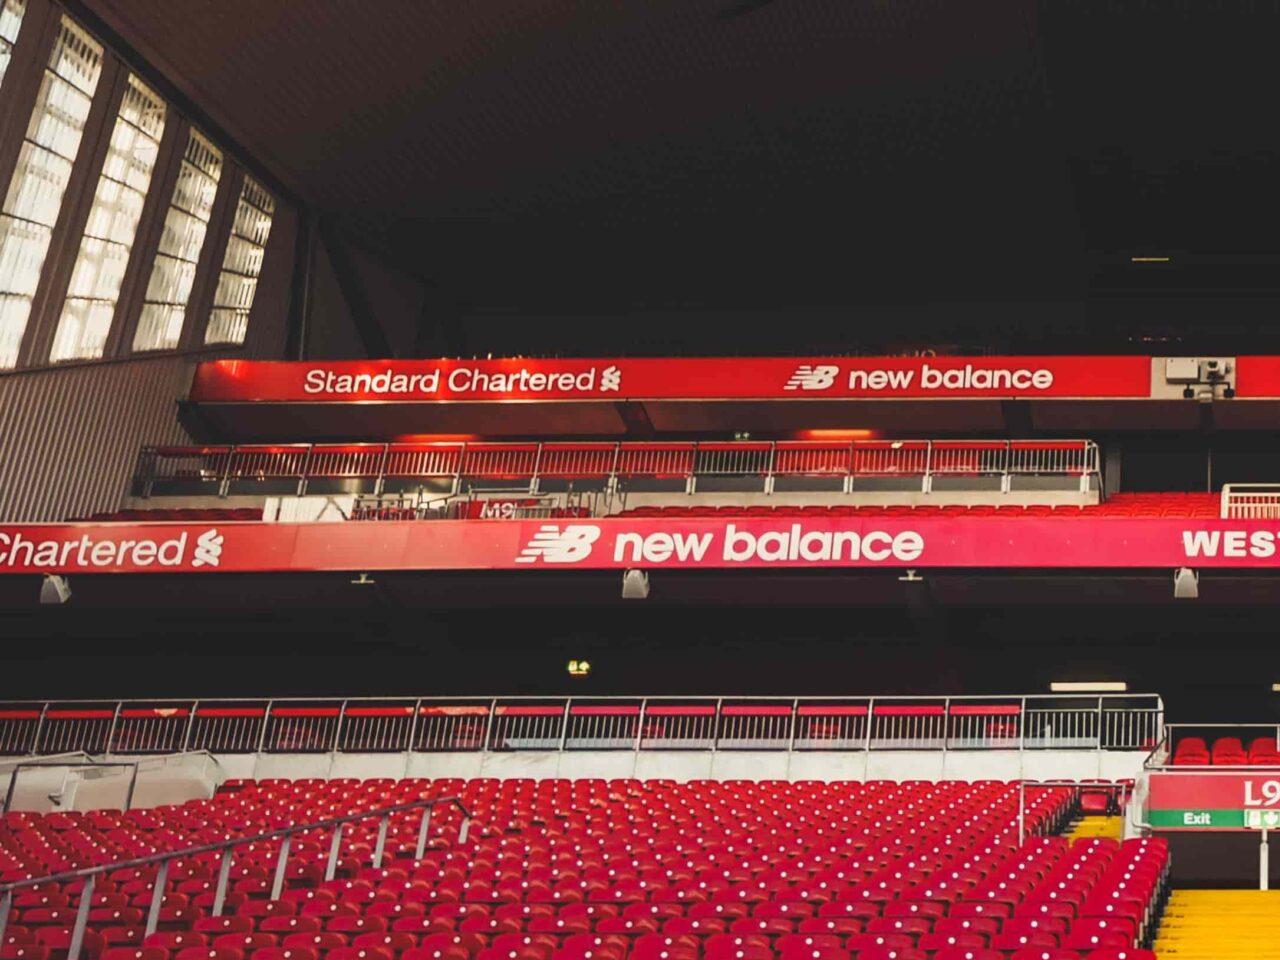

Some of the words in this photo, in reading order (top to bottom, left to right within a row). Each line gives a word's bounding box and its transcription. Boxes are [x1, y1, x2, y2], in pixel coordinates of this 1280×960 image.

[304, 368, 441, 394] Standard
[447, 367, 595, 392] Chartered
[849, 370, 914, 389] new
[921, 364, 1053, 389] balance
[613, 532, 714, 563] new
[722, 523, 925, 562] balance
[1183, 812, 1211, 825] Exit
